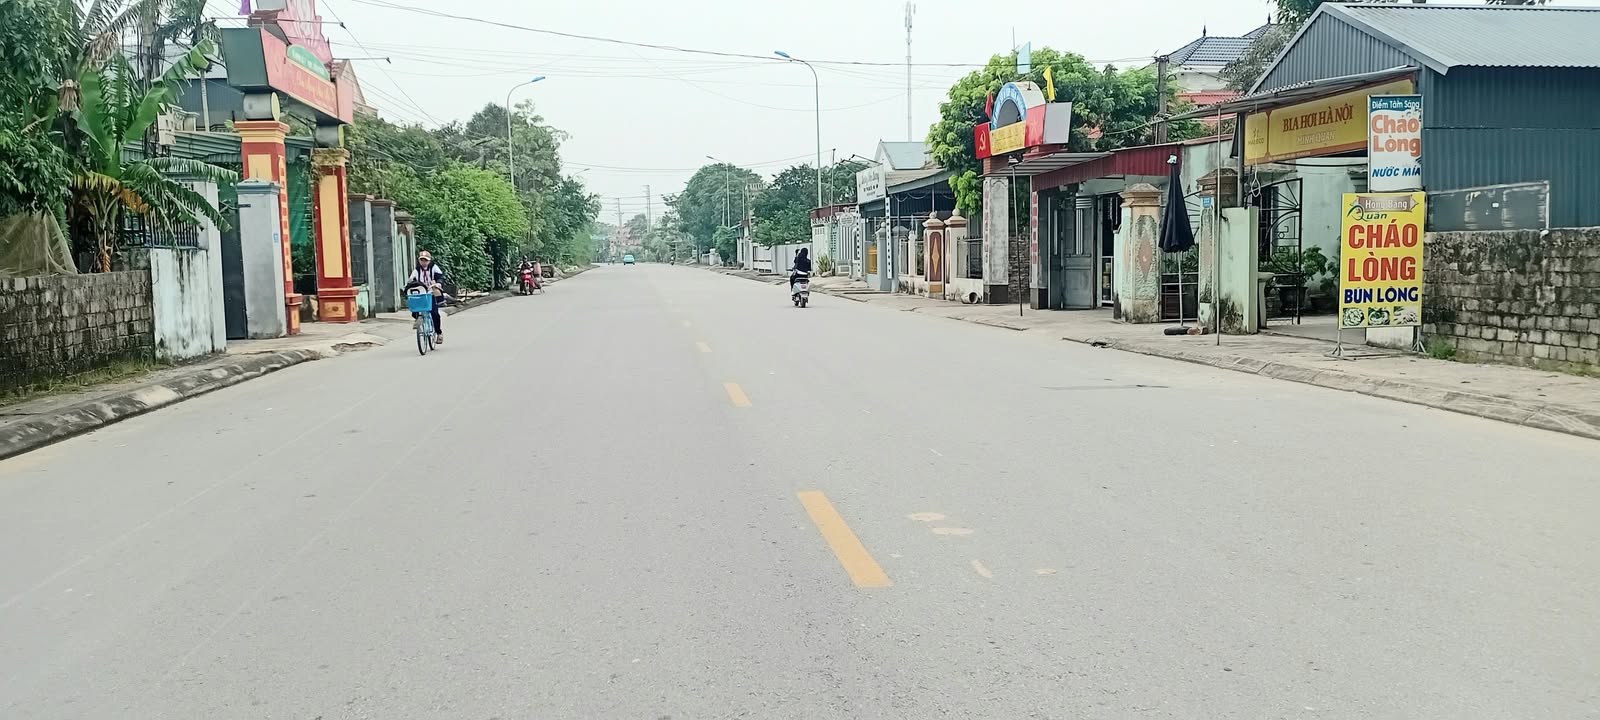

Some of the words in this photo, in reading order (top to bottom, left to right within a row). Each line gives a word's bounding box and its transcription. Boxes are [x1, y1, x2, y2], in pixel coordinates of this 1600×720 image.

[1283, 118, 1299, 133] BIA
[1301, 113, 1318, 130] HƠI
[1319, 106, 1333, 125] HÀ
[1335, 104, 1354, 124] NỘI
[1373, 134, 1421, 157] Lòng
[1372, 166, 1399, 177] NƯỚC
[1402, 165, 1420, 176] MÍA
[1348, 219, 1418, 249] CHÁO
[1348, 252, 1416, 282] LÒNG
[1344, 287, 1373, 304] BÚN
[1377, 286, 1419, 303] LÒNG
